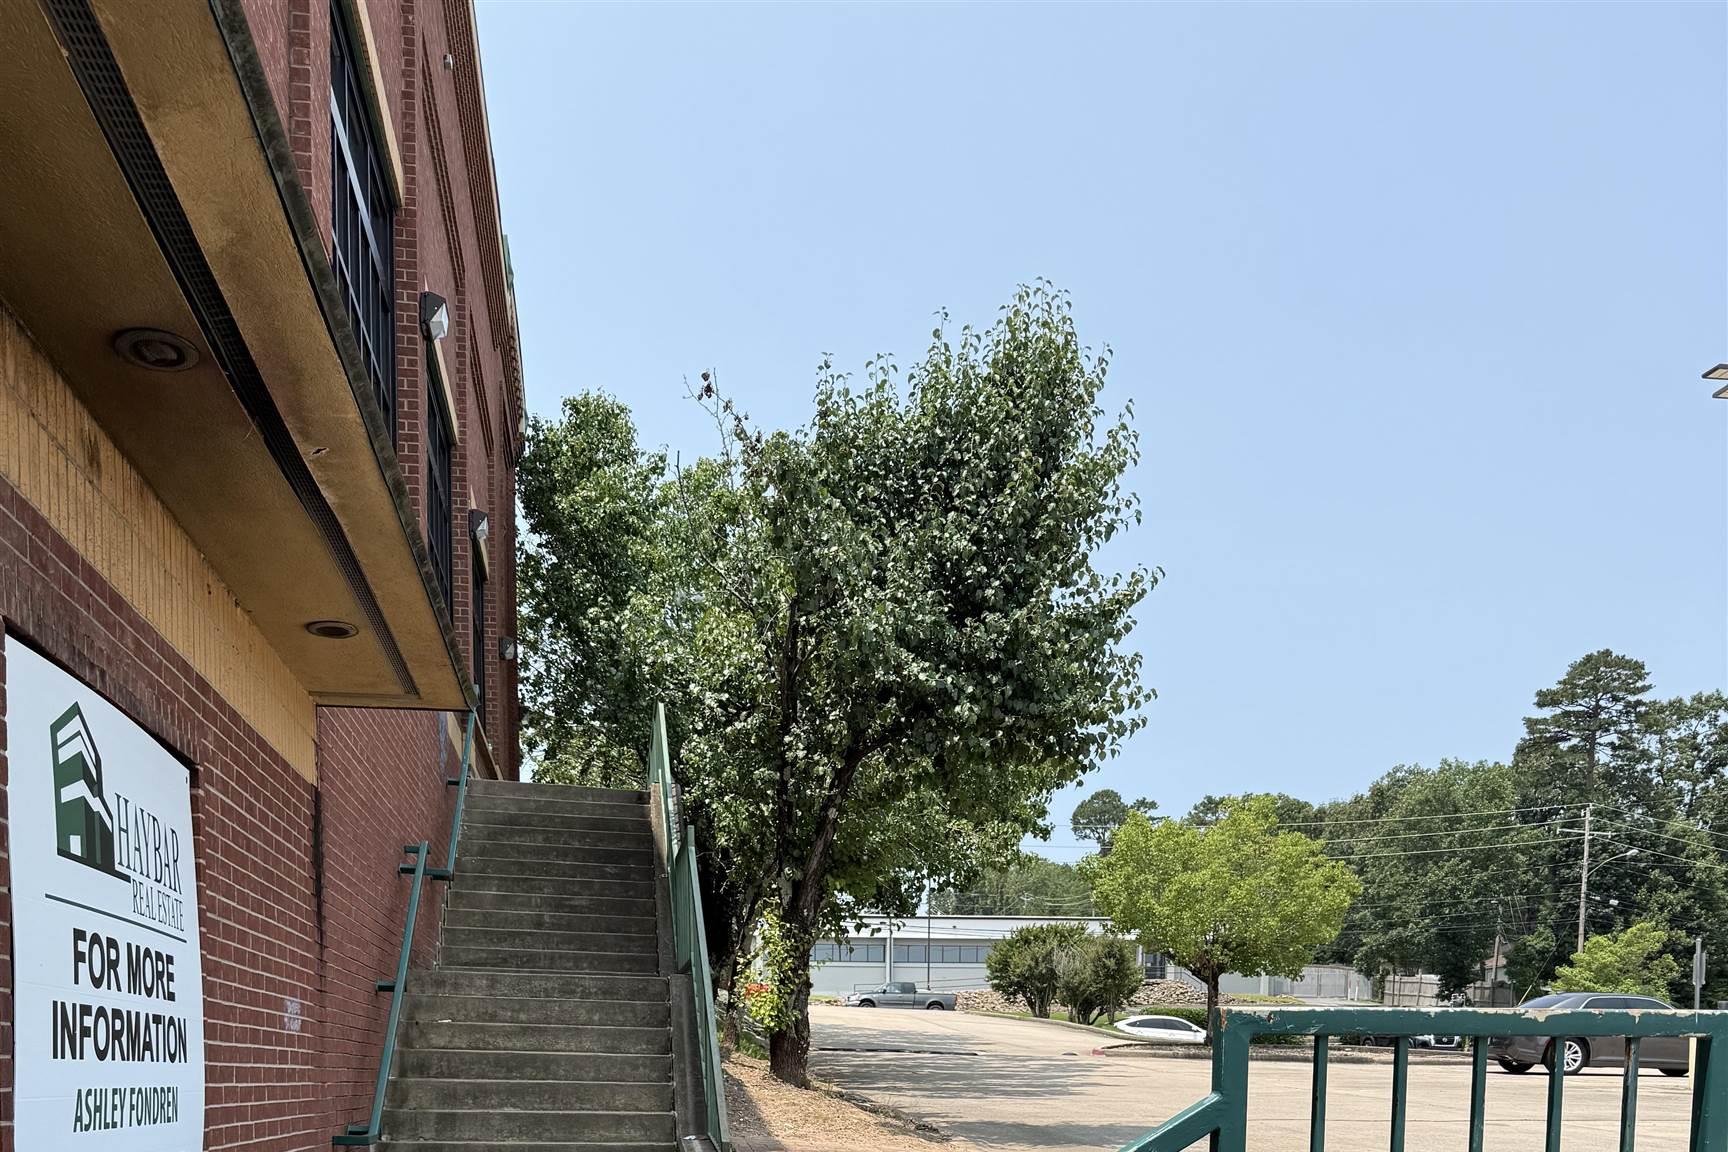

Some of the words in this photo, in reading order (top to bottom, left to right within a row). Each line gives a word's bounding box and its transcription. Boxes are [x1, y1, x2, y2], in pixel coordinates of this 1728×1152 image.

[114, 792, 182, 895] HAYBAR
[132, 878, 156, 921] REAL
[157, 890, 185, 932] ESTATE
[73, 928, 122, 992] FOR
[126, 942, 176, 1002] MORE
[52, 1000, 187, 1064] INFORMATION
[73, 1088, 127, 1133] ASHLEY
[129, 1086, 179, 1127] FONDREN
